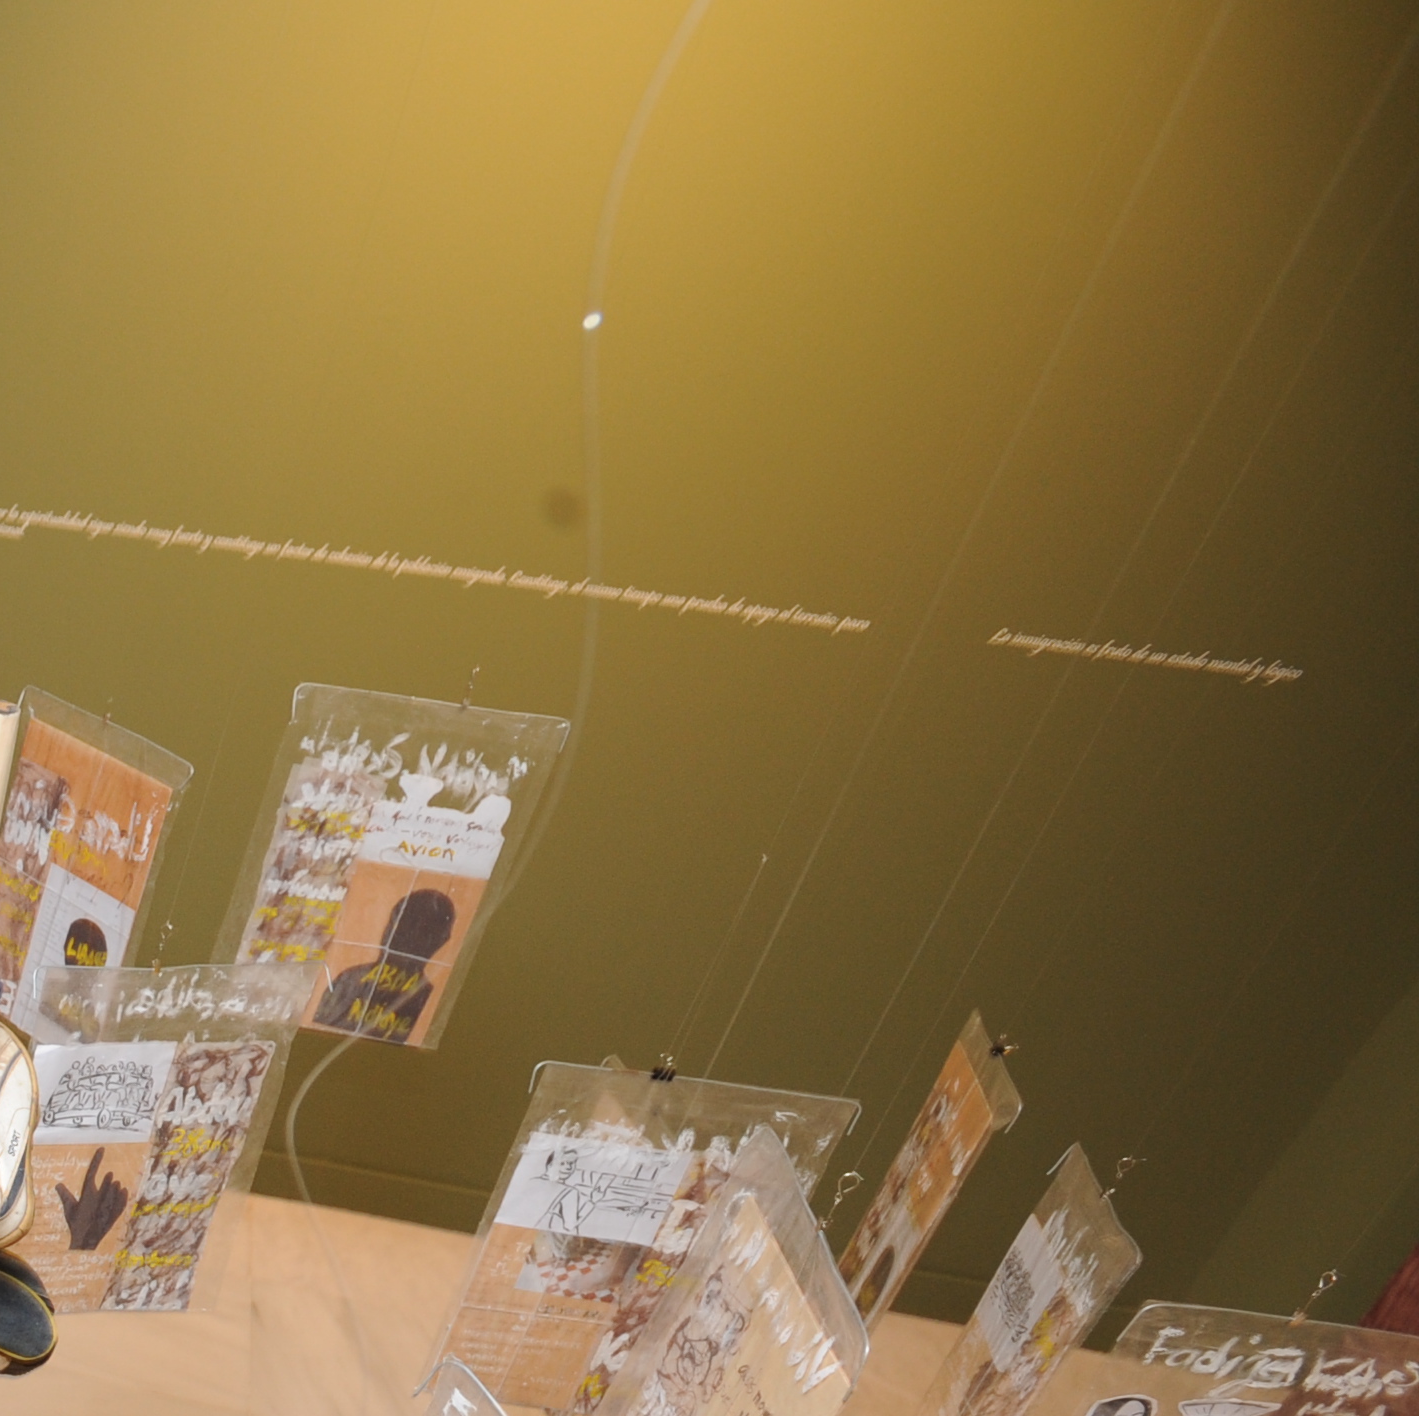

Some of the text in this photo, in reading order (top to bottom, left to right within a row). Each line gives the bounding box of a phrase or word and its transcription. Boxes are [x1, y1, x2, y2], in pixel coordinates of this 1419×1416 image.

[7, 503, 18, 520] la
[148, 527, 173, 548] muy
[199, 534, 213, 553] y
[265, 542, 280, 554] un
[276, 537, 313, 562] factor
[314, 542, 329, 560] de
[370, 549, 386, 567] de
[386, 551, 399, 569] la
[727, 594, 745, 612] de
[990, 627, 1012, 643] La
[1012, 631, 1086, 656] inmigración
[1092, 639, 1133, 661] fruto
[1133, 643, 1150, 659] de
[1150, 651, 1167, 663] un
[1167, 649, 1209, 668] estado
[1209, 656, 1255, 674] mental
[1263, 659, 1304, 687] lógico
[7, 1129, 20, 1158] SPORT
